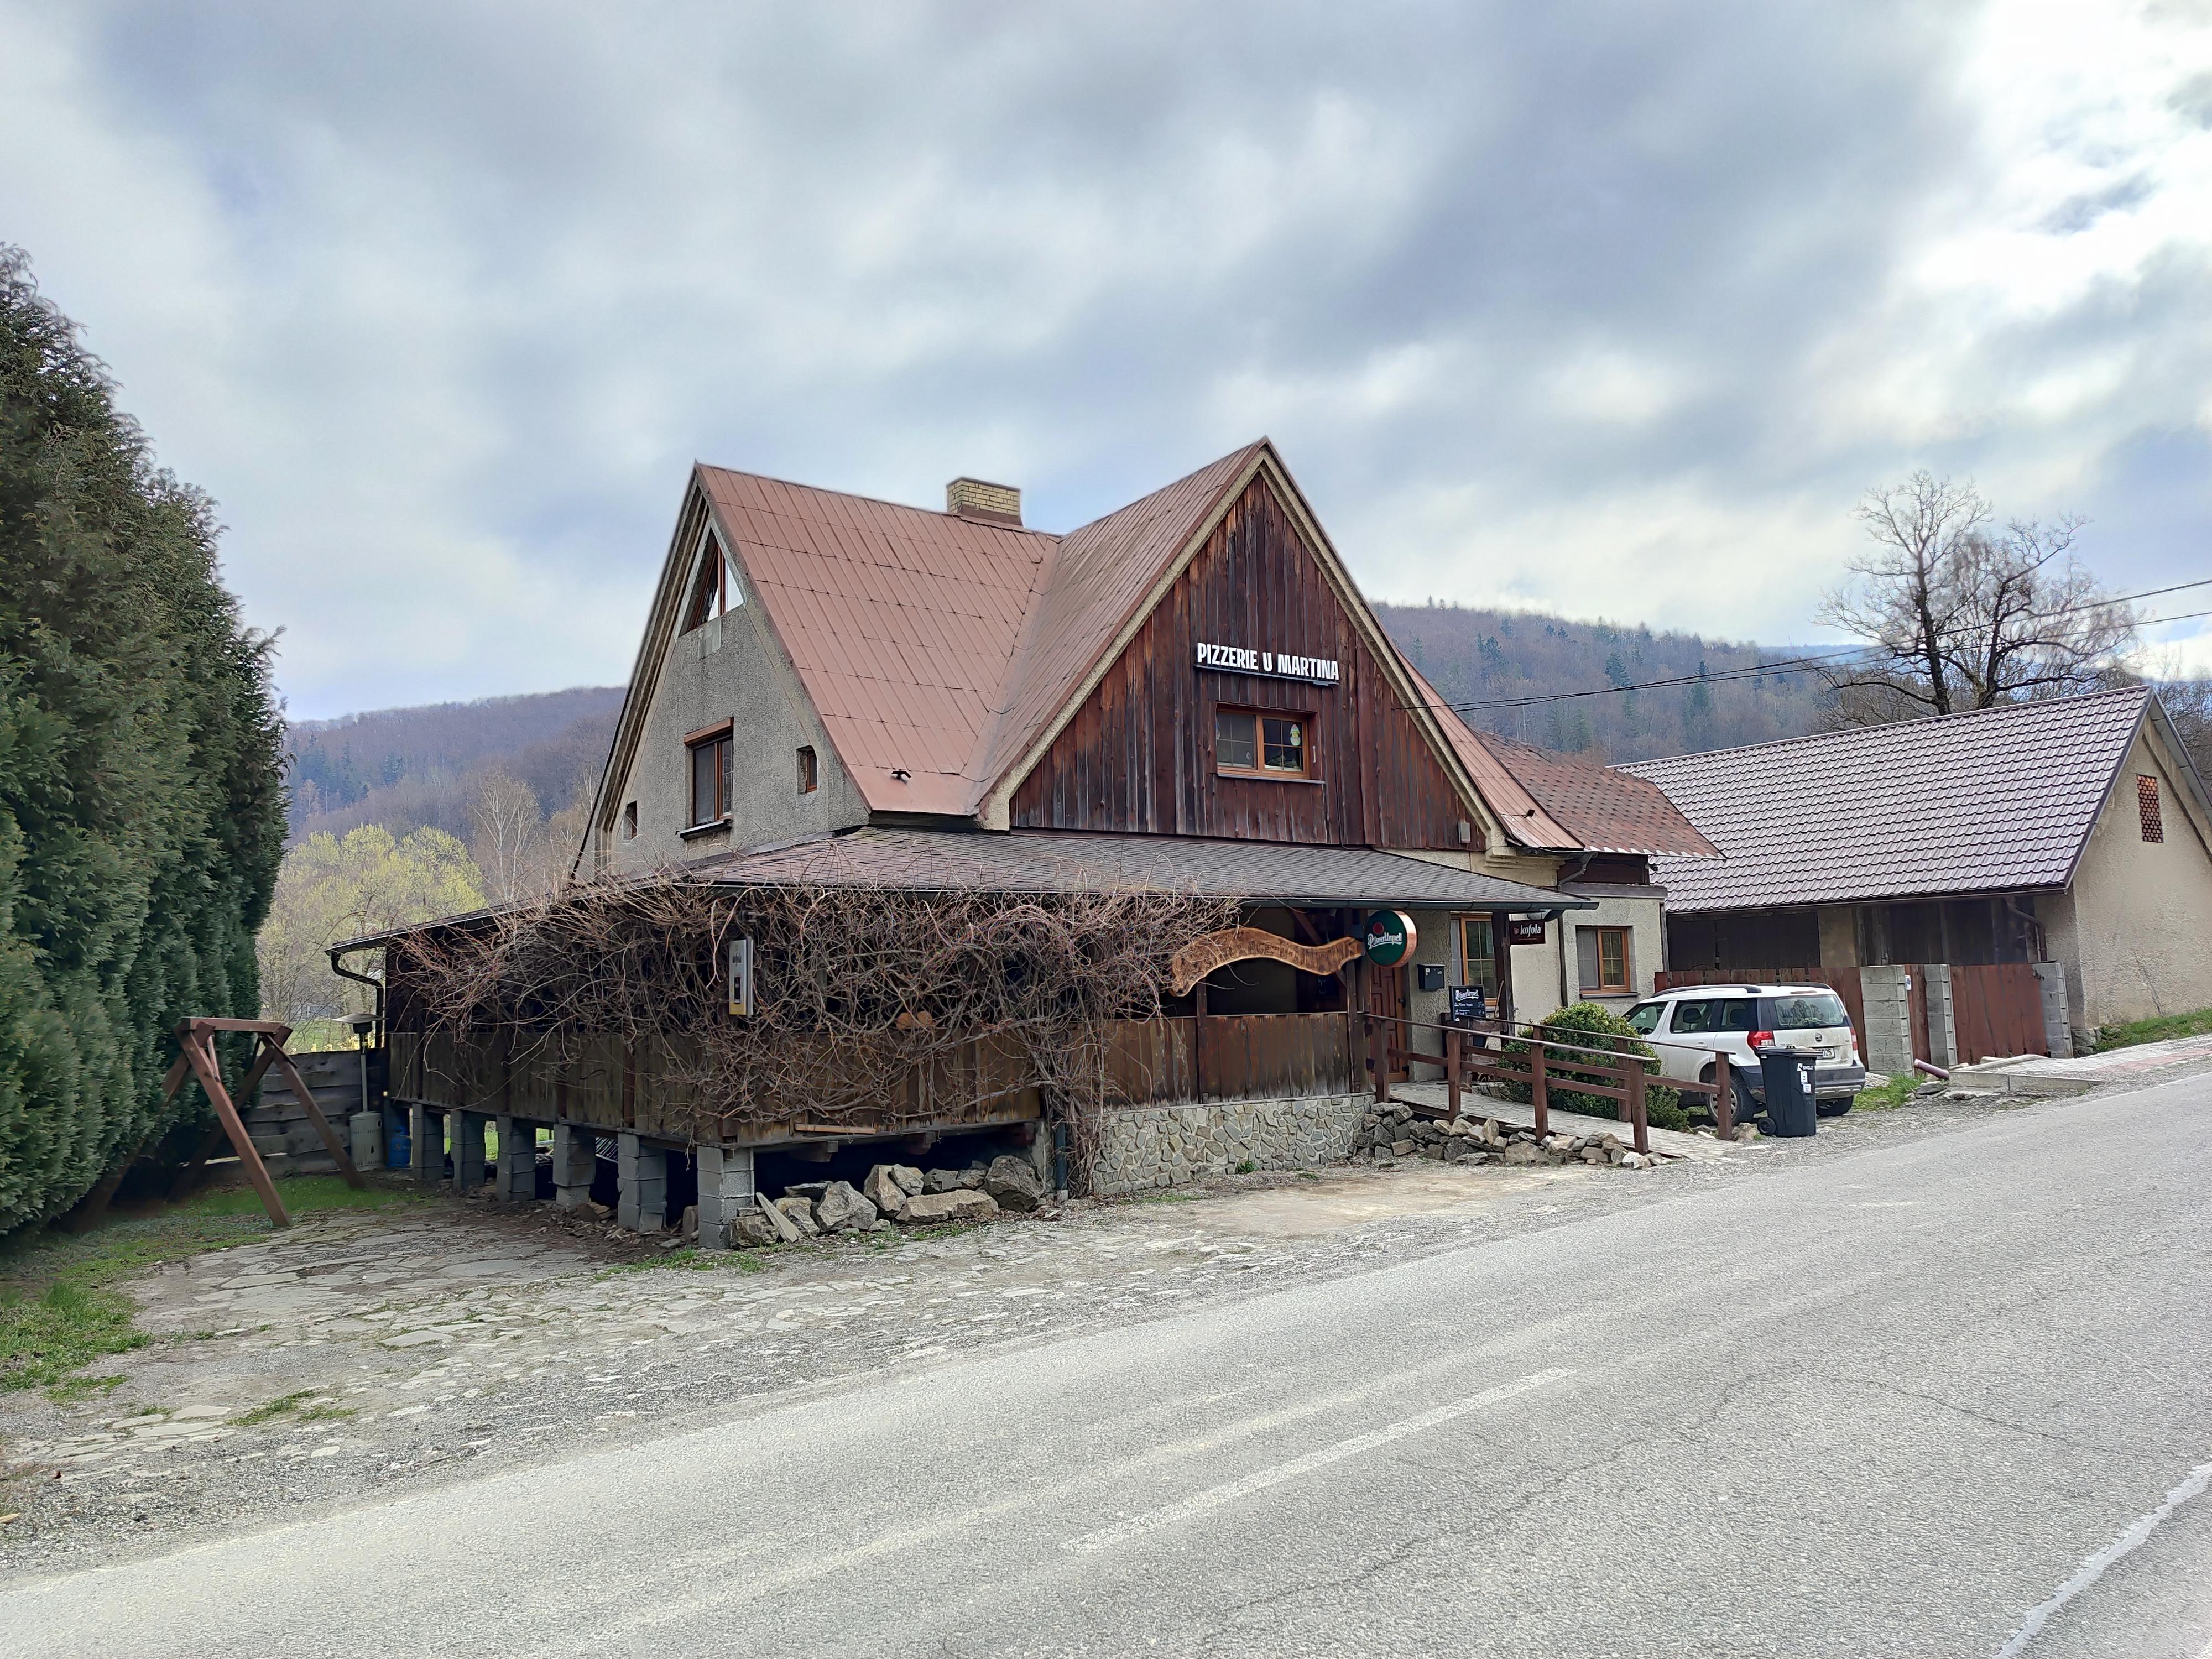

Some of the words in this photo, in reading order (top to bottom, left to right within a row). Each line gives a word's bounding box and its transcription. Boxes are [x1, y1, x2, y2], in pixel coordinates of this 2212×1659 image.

[1197, 643, 1258, 670] PIZZERIE
[1262, 652, 1272, 671] U
[1277, 654, 1339, 680] MARTINA
[1520, 924, 1541, 937] kofola
[1368, 933, 1385, 950] Pilsner
